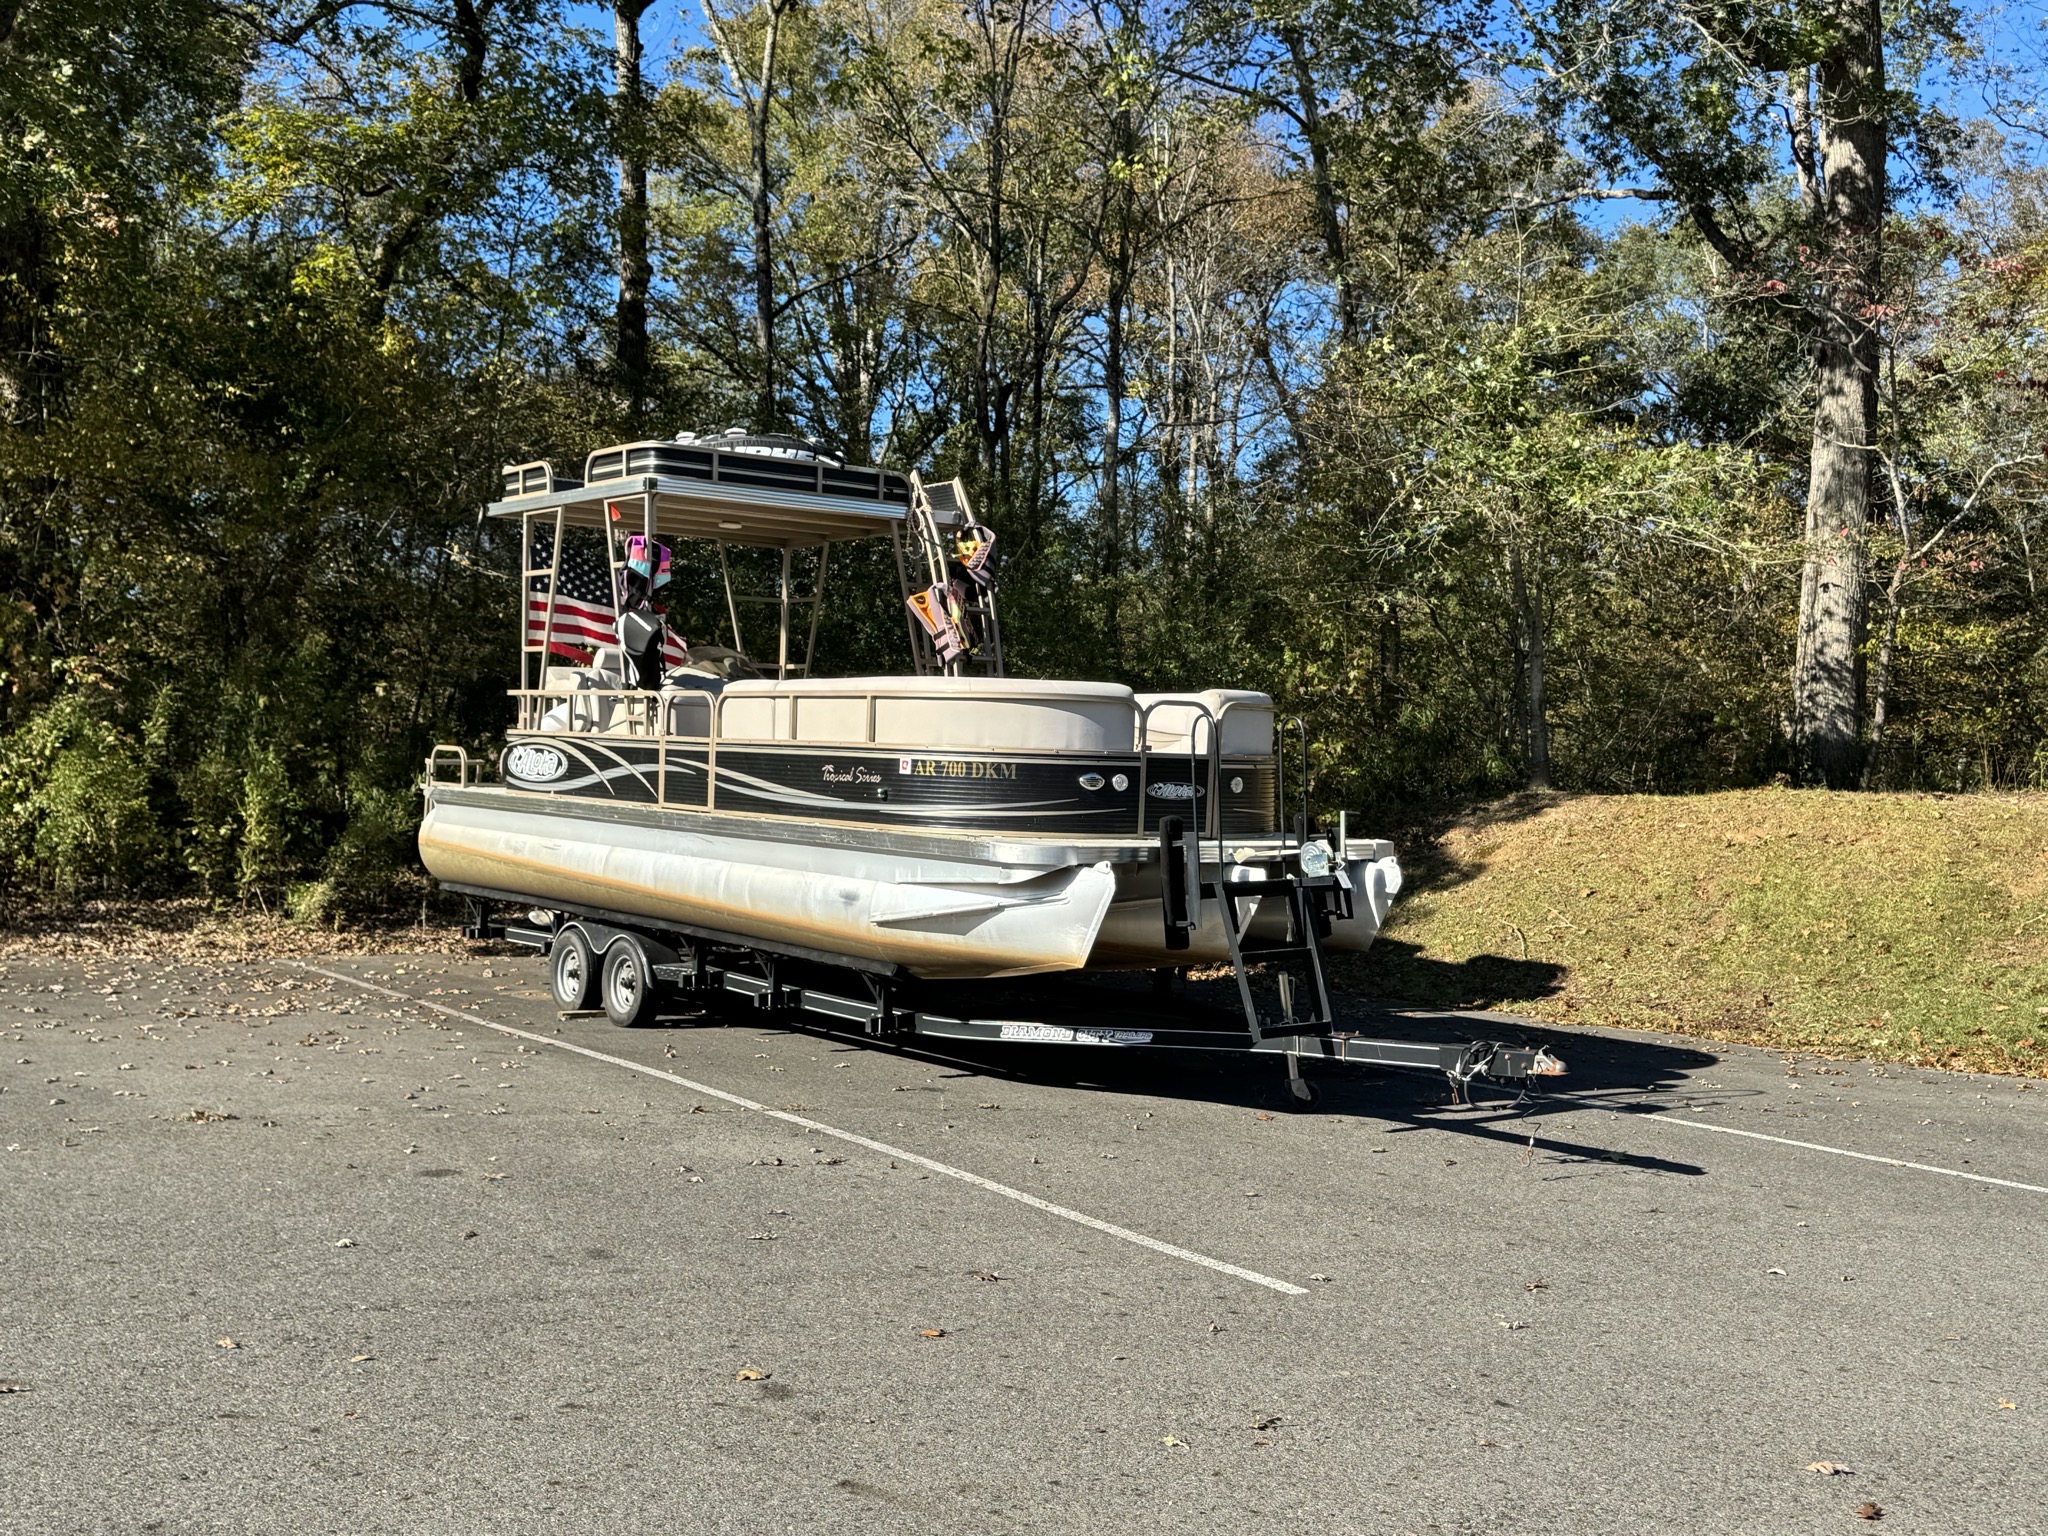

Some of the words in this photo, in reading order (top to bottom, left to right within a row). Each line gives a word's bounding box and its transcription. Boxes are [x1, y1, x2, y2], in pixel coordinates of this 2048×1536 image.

[821, 764, 855, 783] Tropical
[855, 766, 882, 784] Series
[914, 760, 937, 776] AR
[940, 761, 967, 778] 700
[971, 762, 1017, 780] DKM
[1000, 1025, 1074, 1041] DIAMOND
[1076, 1028, 1113, 1043] CITY
